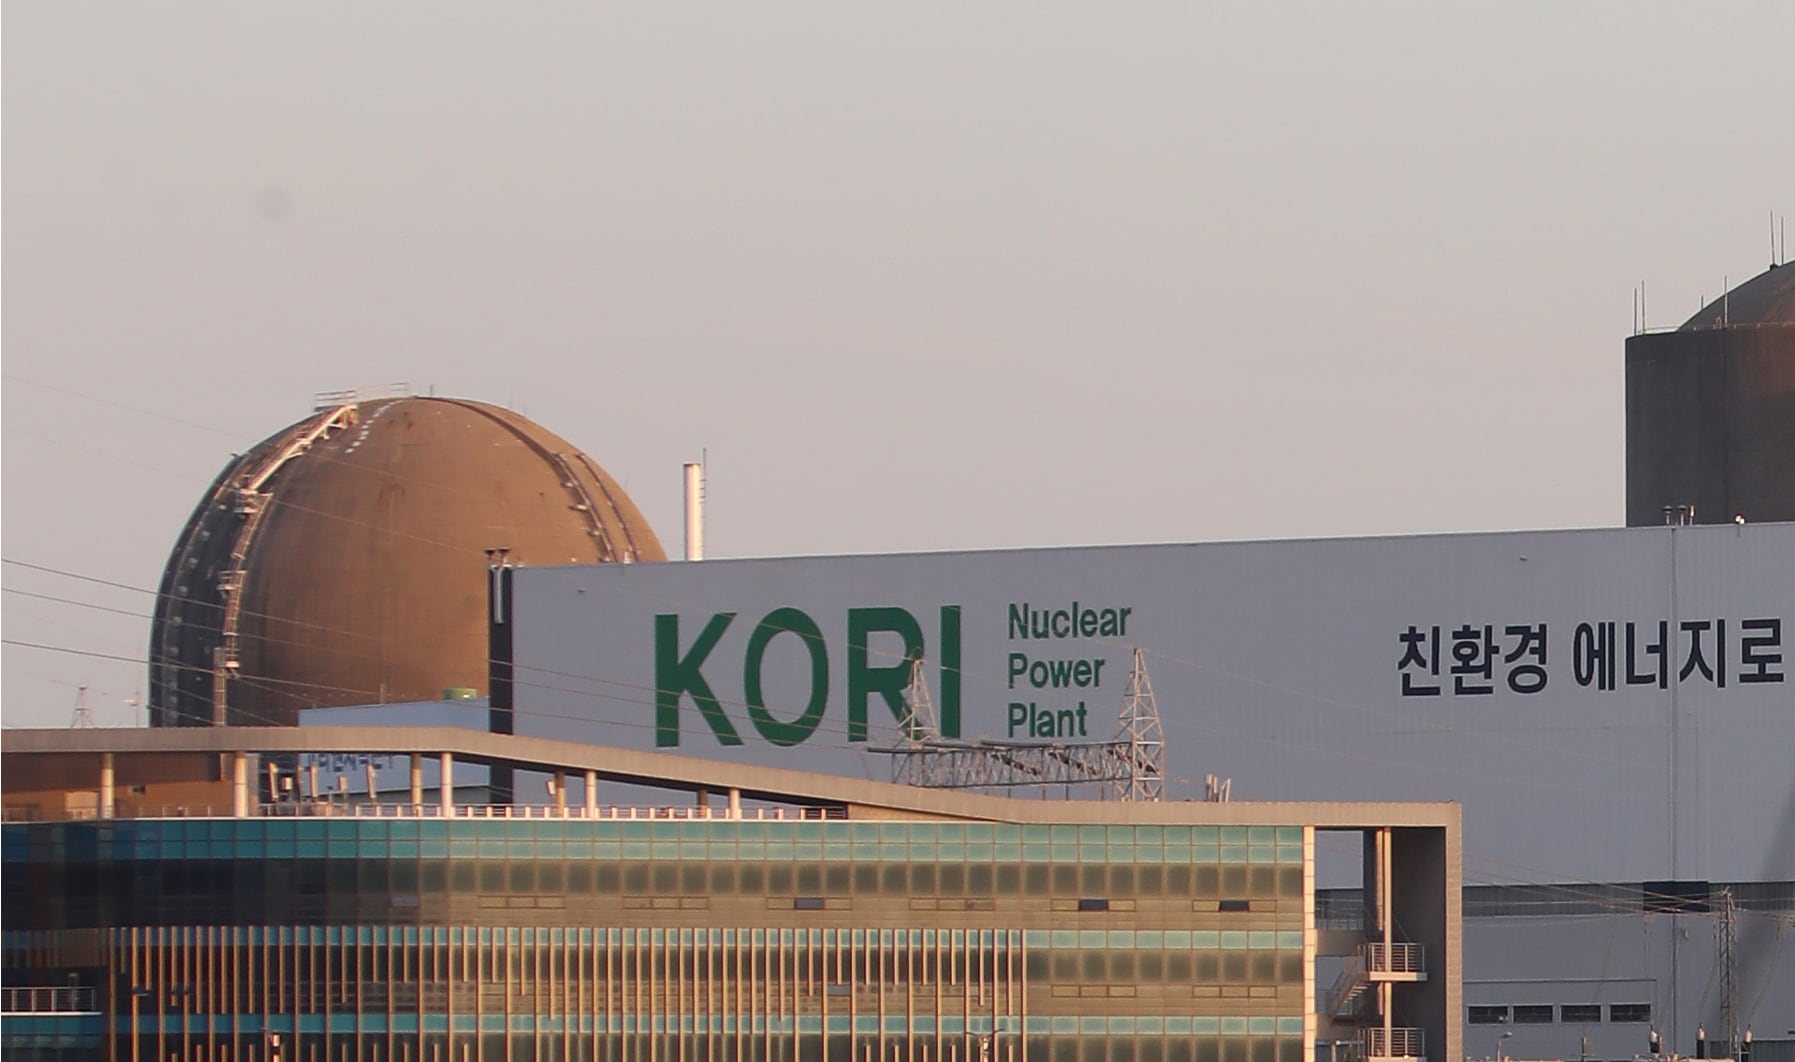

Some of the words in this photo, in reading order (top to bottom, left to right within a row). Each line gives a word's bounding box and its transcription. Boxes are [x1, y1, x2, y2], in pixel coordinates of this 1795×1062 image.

[1008, 601, 1132, 640] Nuclear
[655, 606, 962, 748] KORI
[1008, 651, 1105, 690] Power
[1397, 623, 1549, 698] 친환경
[1572, 618, 1786, 692] 에너지로
[1008, 700, 1087, 739] Plant
